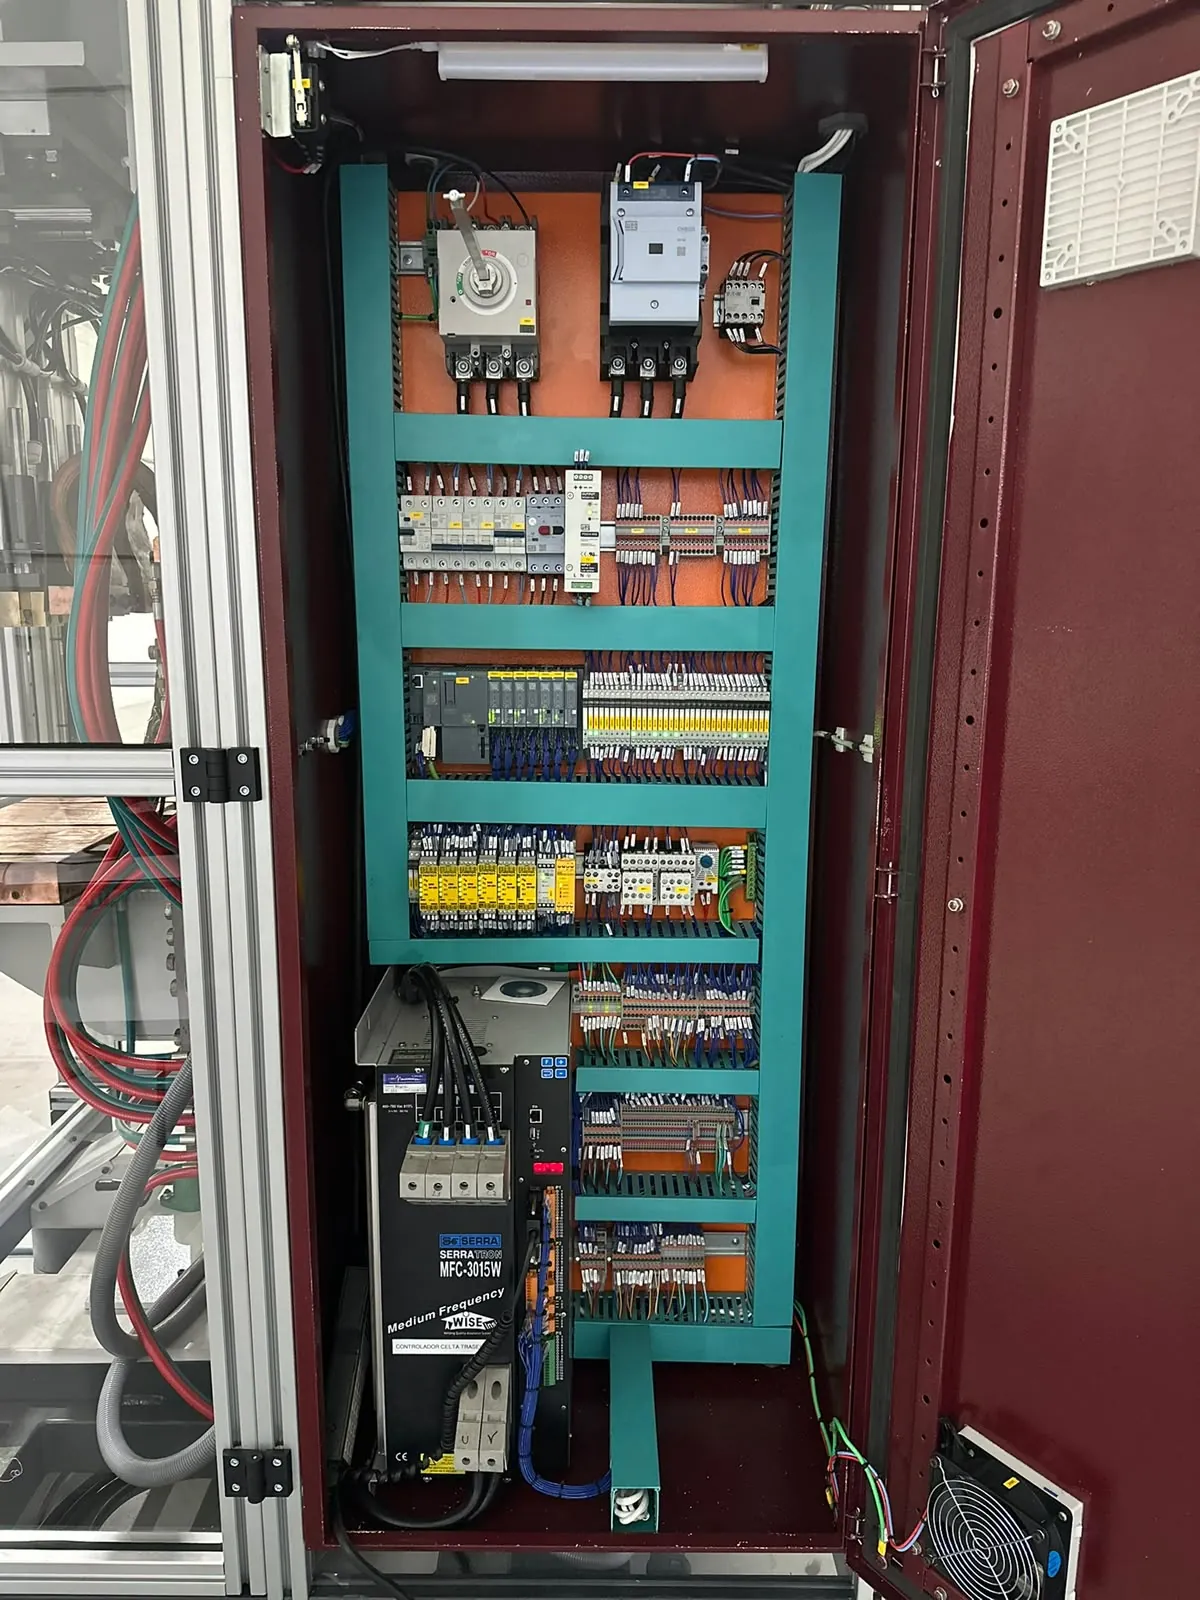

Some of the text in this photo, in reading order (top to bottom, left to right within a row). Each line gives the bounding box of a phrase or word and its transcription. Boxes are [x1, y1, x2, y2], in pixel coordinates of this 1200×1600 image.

[461, 1236, 498, 1245] SERRA
[440, 1249, 502, 1259] SERRATRON
[387, 1287, 505, 1334] Medium Frequency
